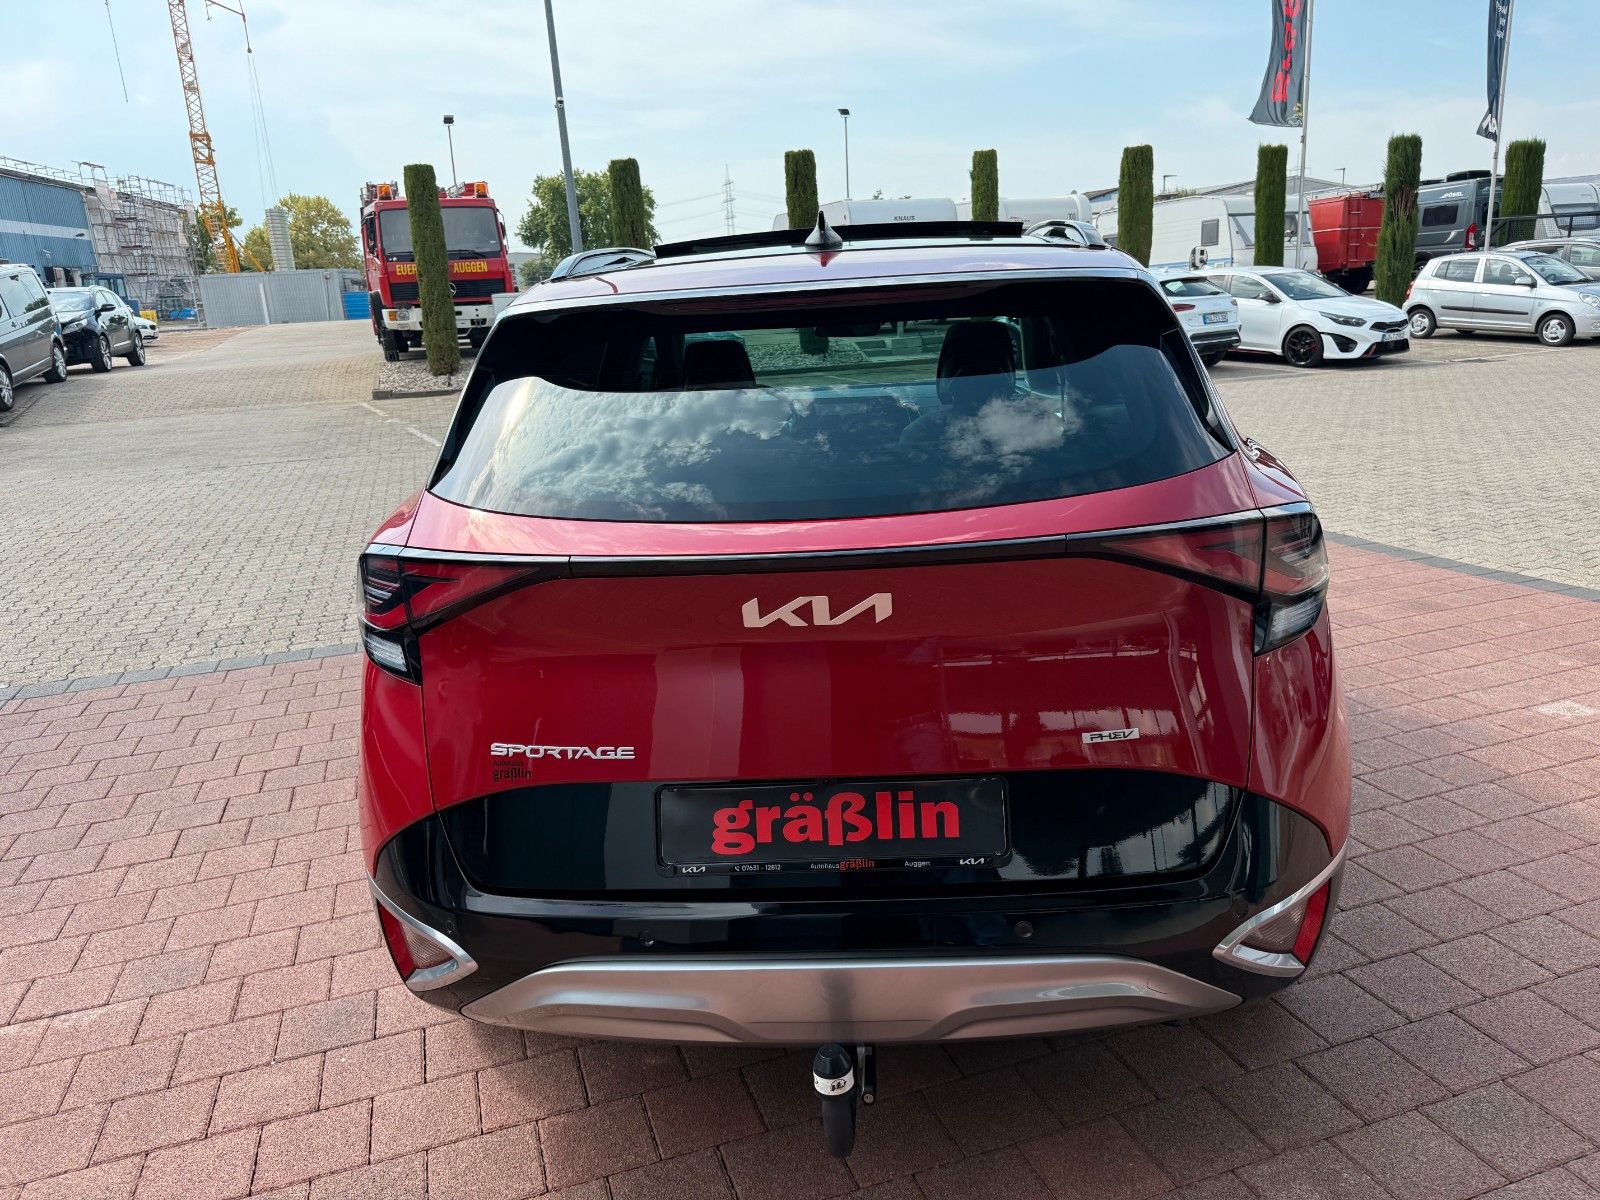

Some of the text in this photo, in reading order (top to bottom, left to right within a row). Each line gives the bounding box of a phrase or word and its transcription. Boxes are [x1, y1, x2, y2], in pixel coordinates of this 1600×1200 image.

[453, 261, 488, 273] AUGGEN
[741, 592, 893, 628] KIA
[1089, 730, 1135, 741] PHEV
[490, 742, 636, 760] SPORTAGE
[493, 767, 532, 782] gräßlin
[711, 791, 960, 855] gräßlin
[682, 866, 706, 874] KIA
[741, 864, 760, 872] 07631
